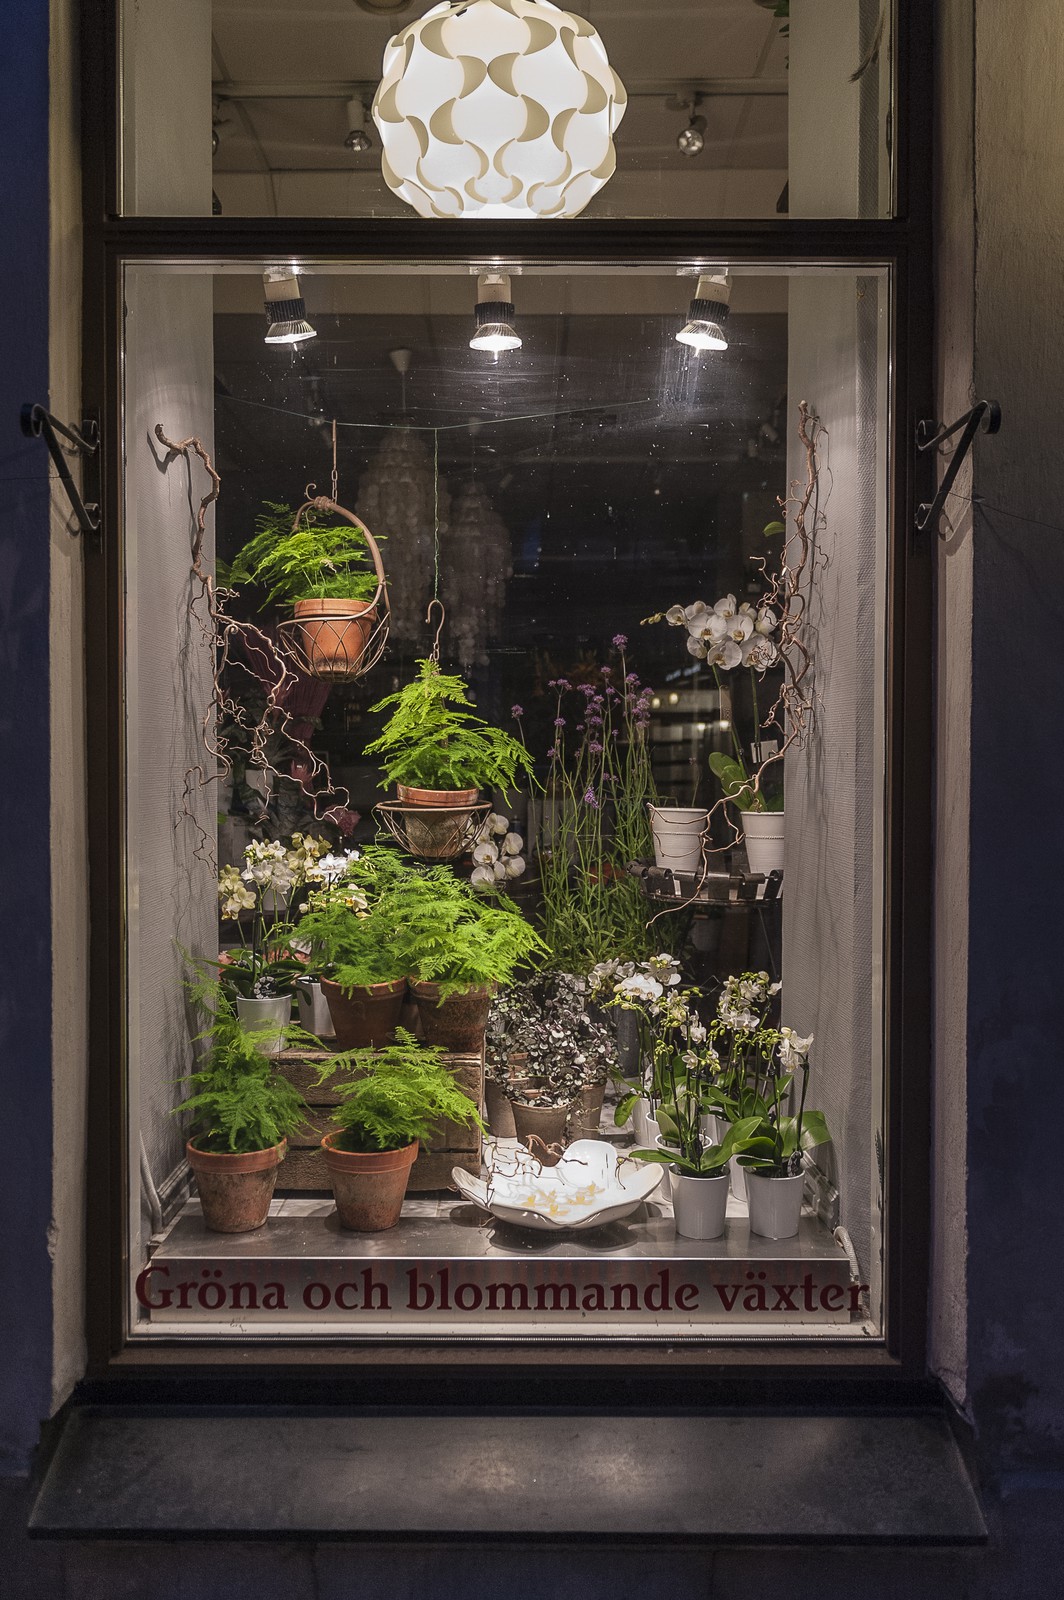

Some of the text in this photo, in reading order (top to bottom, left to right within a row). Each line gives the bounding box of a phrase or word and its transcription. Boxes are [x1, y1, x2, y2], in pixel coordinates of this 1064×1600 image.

[135, 1266, 870, 1312] Gröna och blommande växter
